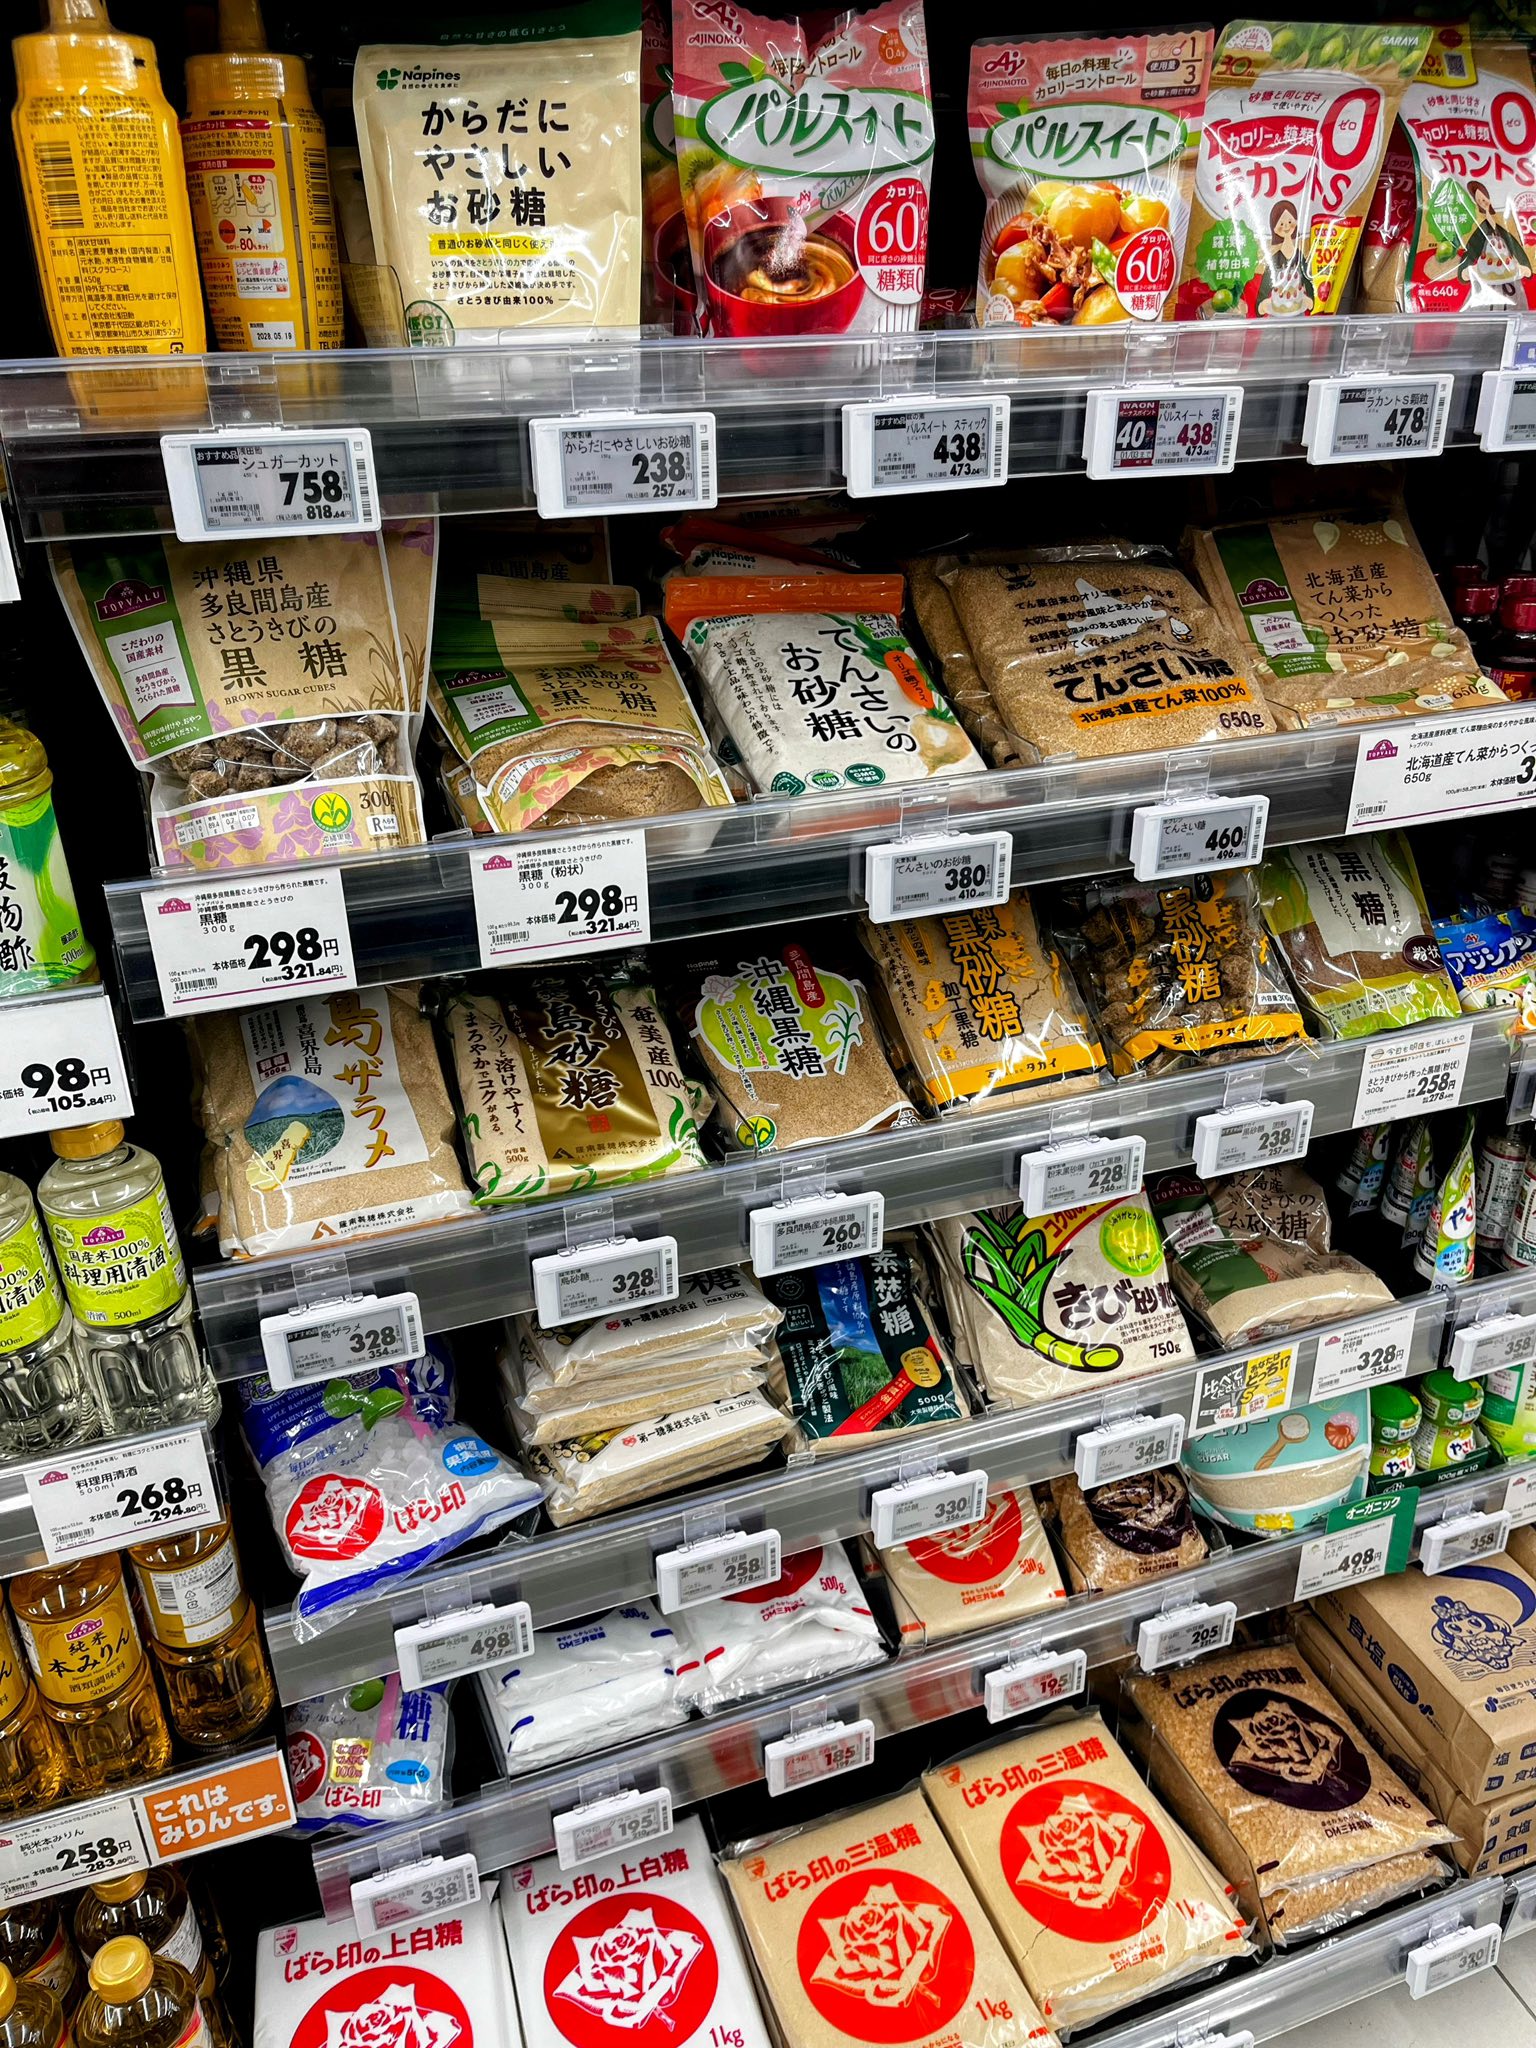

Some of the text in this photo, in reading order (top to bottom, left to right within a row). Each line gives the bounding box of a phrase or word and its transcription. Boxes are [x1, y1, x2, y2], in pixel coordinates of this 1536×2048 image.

[402, 66, 460, 82] Napines
[1045, 57, 1119, 80] 毎日の料理で
[978, 78, 1027, 88] AJINOMOTO
[1035, 73, 1136, 100] カロリーコントロール
[421, 97, 569, 136] からだに
[1004, 116, 1170, 167] パルスイート
[422, 143, 572, 181] やさしい
[427, 187, 546, 227] お砂糖
[565, 435, 691, 454] からだにやさしいお砂糖
[242, 454, 338, 471] シュガーカット
[192, 556, 284, 590] 沖縄県
[1304, 562, 1389, 589] 北海道産
[101, 590, 162, 615] TOPVALU
[200, 581, 333, 619] 多良間島産
[1310, 581, 1393, 606] てん菜から
[1319, 603, 1383, 623] つくった
[207, 616, 337, 646] さとうきびの
[224, 683, 336, 706] BROWN SUGAR CUBES
[780, 641, 863, 742] お砂糖
[1079, 682, 1246, 724] 北海道産てん菜100%
[1219, 712, 1265, 729] 650g
[1403, 772, 1432, 784] 650g
[1163, 821, 1206, 834] てんさい糖
[896, 855, 971, 874] てんさいのお砂糖
[1333, 851, 1387, 927] 黒糖
[200, 912, 228, 926] 黒糖
[944, 916, 1022, 1040] 黒砂糖
[743, 958, 825, 1078] 沖縄黒糖
[941, 981, 980, 1049] 加工黒糖
[321, 991, 396, 1168] 島ザラメ
[69, 1238, 150, 1264] 国産米100%
[64, 1246, 166, 1287] 料理用清酒
[113, 1308, 142, 1320] 500ml
[1149, 1341, 1181, 1358] 750g
[75, 1466, 138, 1489] 料理用清酒
[1345, 1495, 1401, 1520] オーガニック
[48, 1627, 130, 1679] 本みりん
[959, 1735, 1110, 1811] ばら印の三温糖
[154, 1784, 229, 1823] これは
[324, 1786, 383, 1808] ばら印
[159, 1793, 286, 1846] みりんです。
[763, 1823, 923, 1904] ばら印の三温糖
[527, 1849, 690, 1916] ばら印の上白糖
[283, 1918, 463, 1984] ばら印の上白糖
[974, 1997, 1014, 2023] 1kg
[708, 2026, 745, 2048] 1kg
